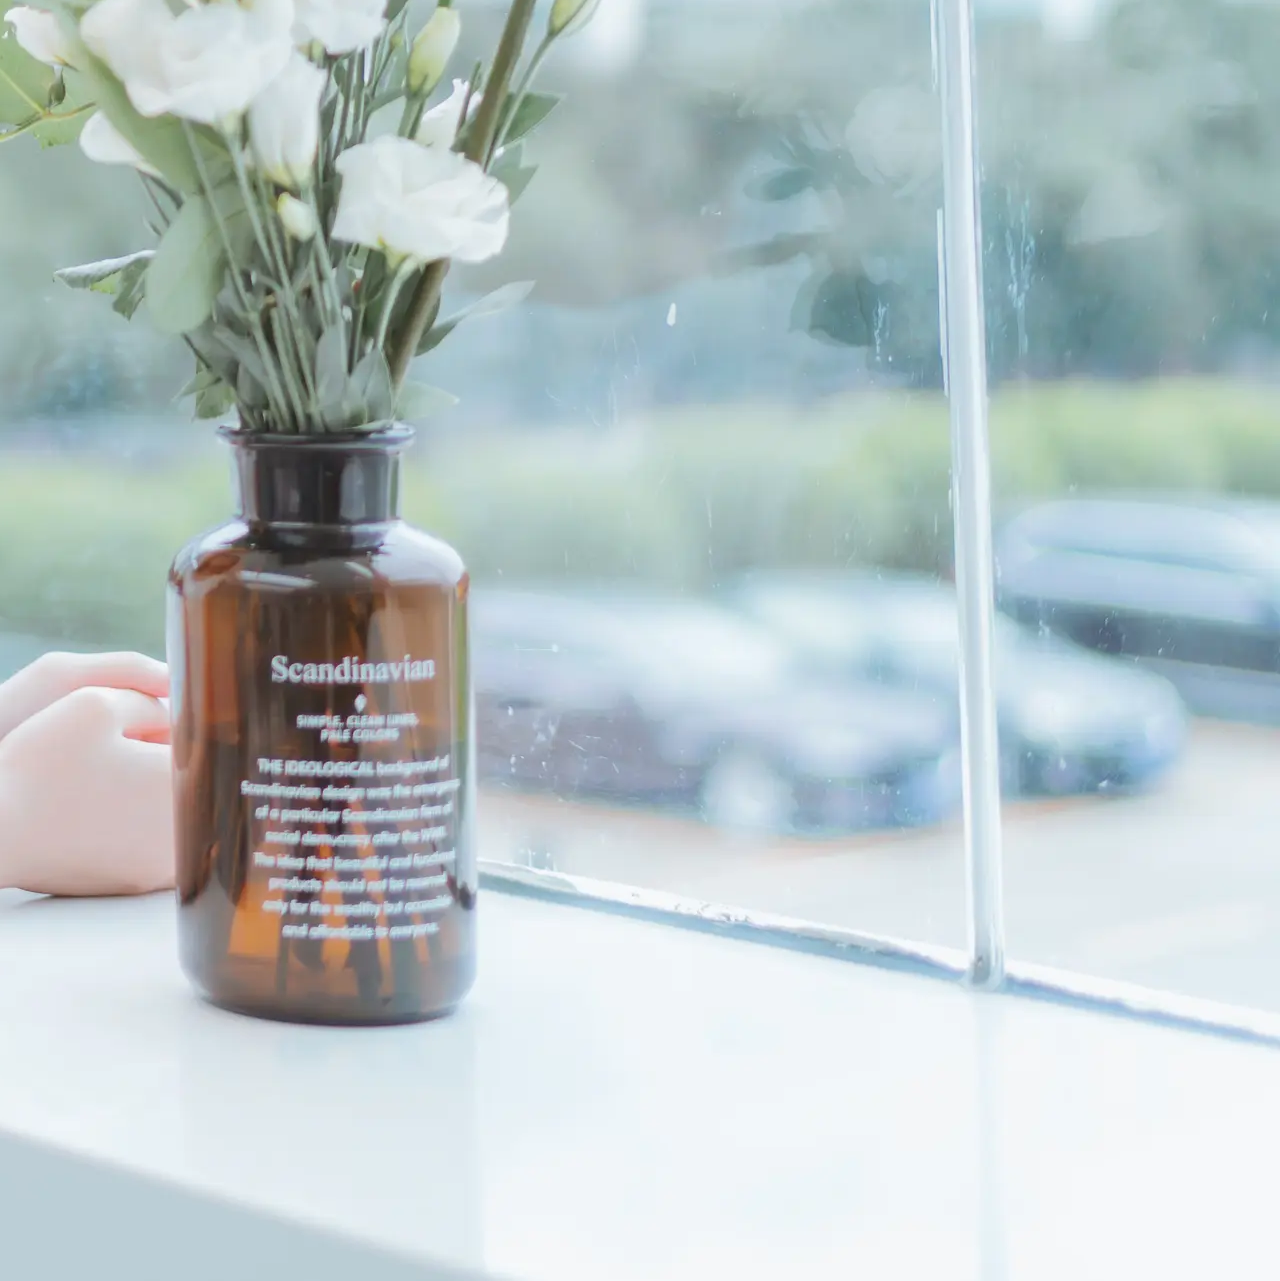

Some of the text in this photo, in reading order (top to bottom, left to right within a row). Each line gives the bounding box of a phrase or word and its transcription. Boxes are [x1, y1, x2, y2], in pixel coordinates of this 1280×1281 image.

[271, 654, 435, 683] Scandinavian
[257, 758, 284, 775] THE
[284, 759, 374, 778] IDEOLOGICAL
